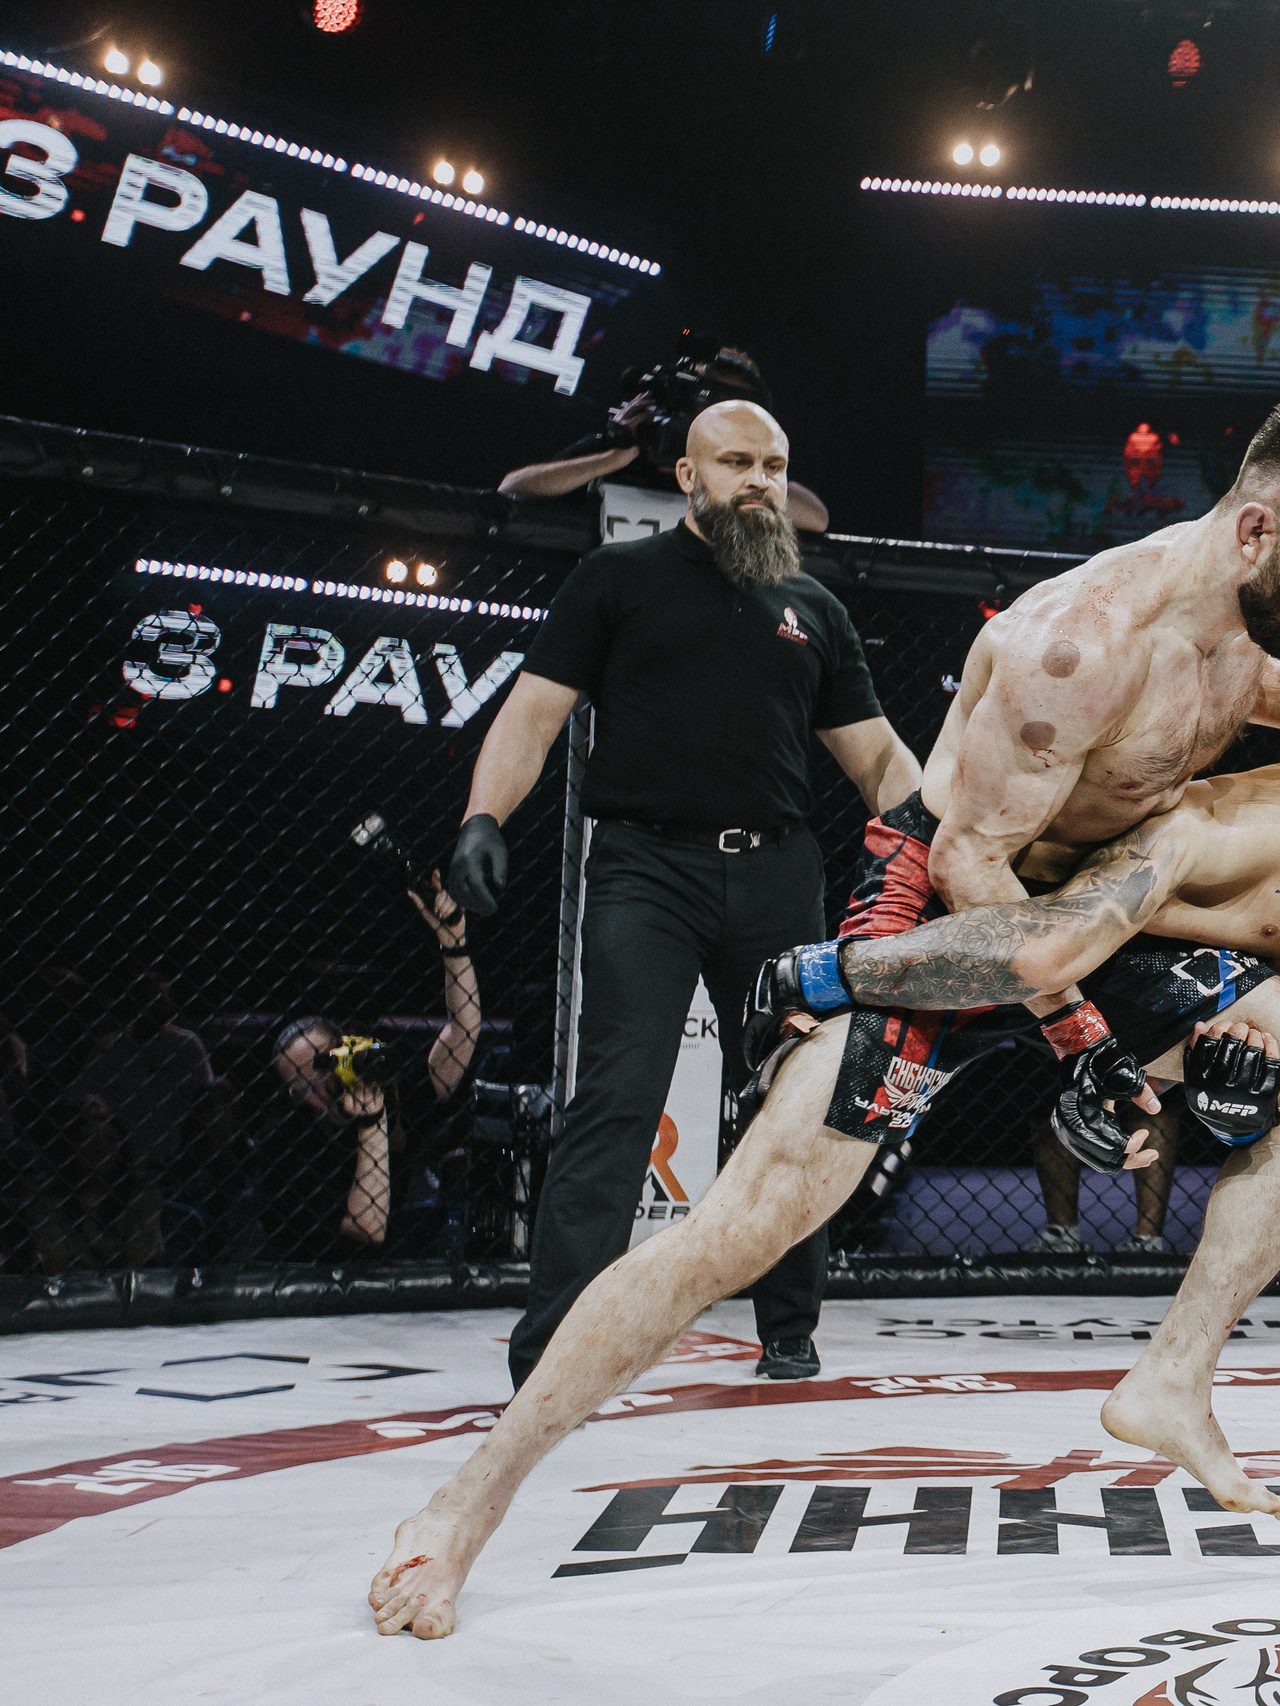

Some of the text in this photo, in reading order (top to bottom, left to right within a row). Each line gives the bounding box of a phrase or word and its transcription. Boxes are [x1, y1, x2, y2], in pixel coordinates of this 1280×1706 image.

[101, 153, 592, 395] РАУНД
[122, 609, 526, 727] 3 РАУ
[1209, 1099, 1259, 1117] MFP
